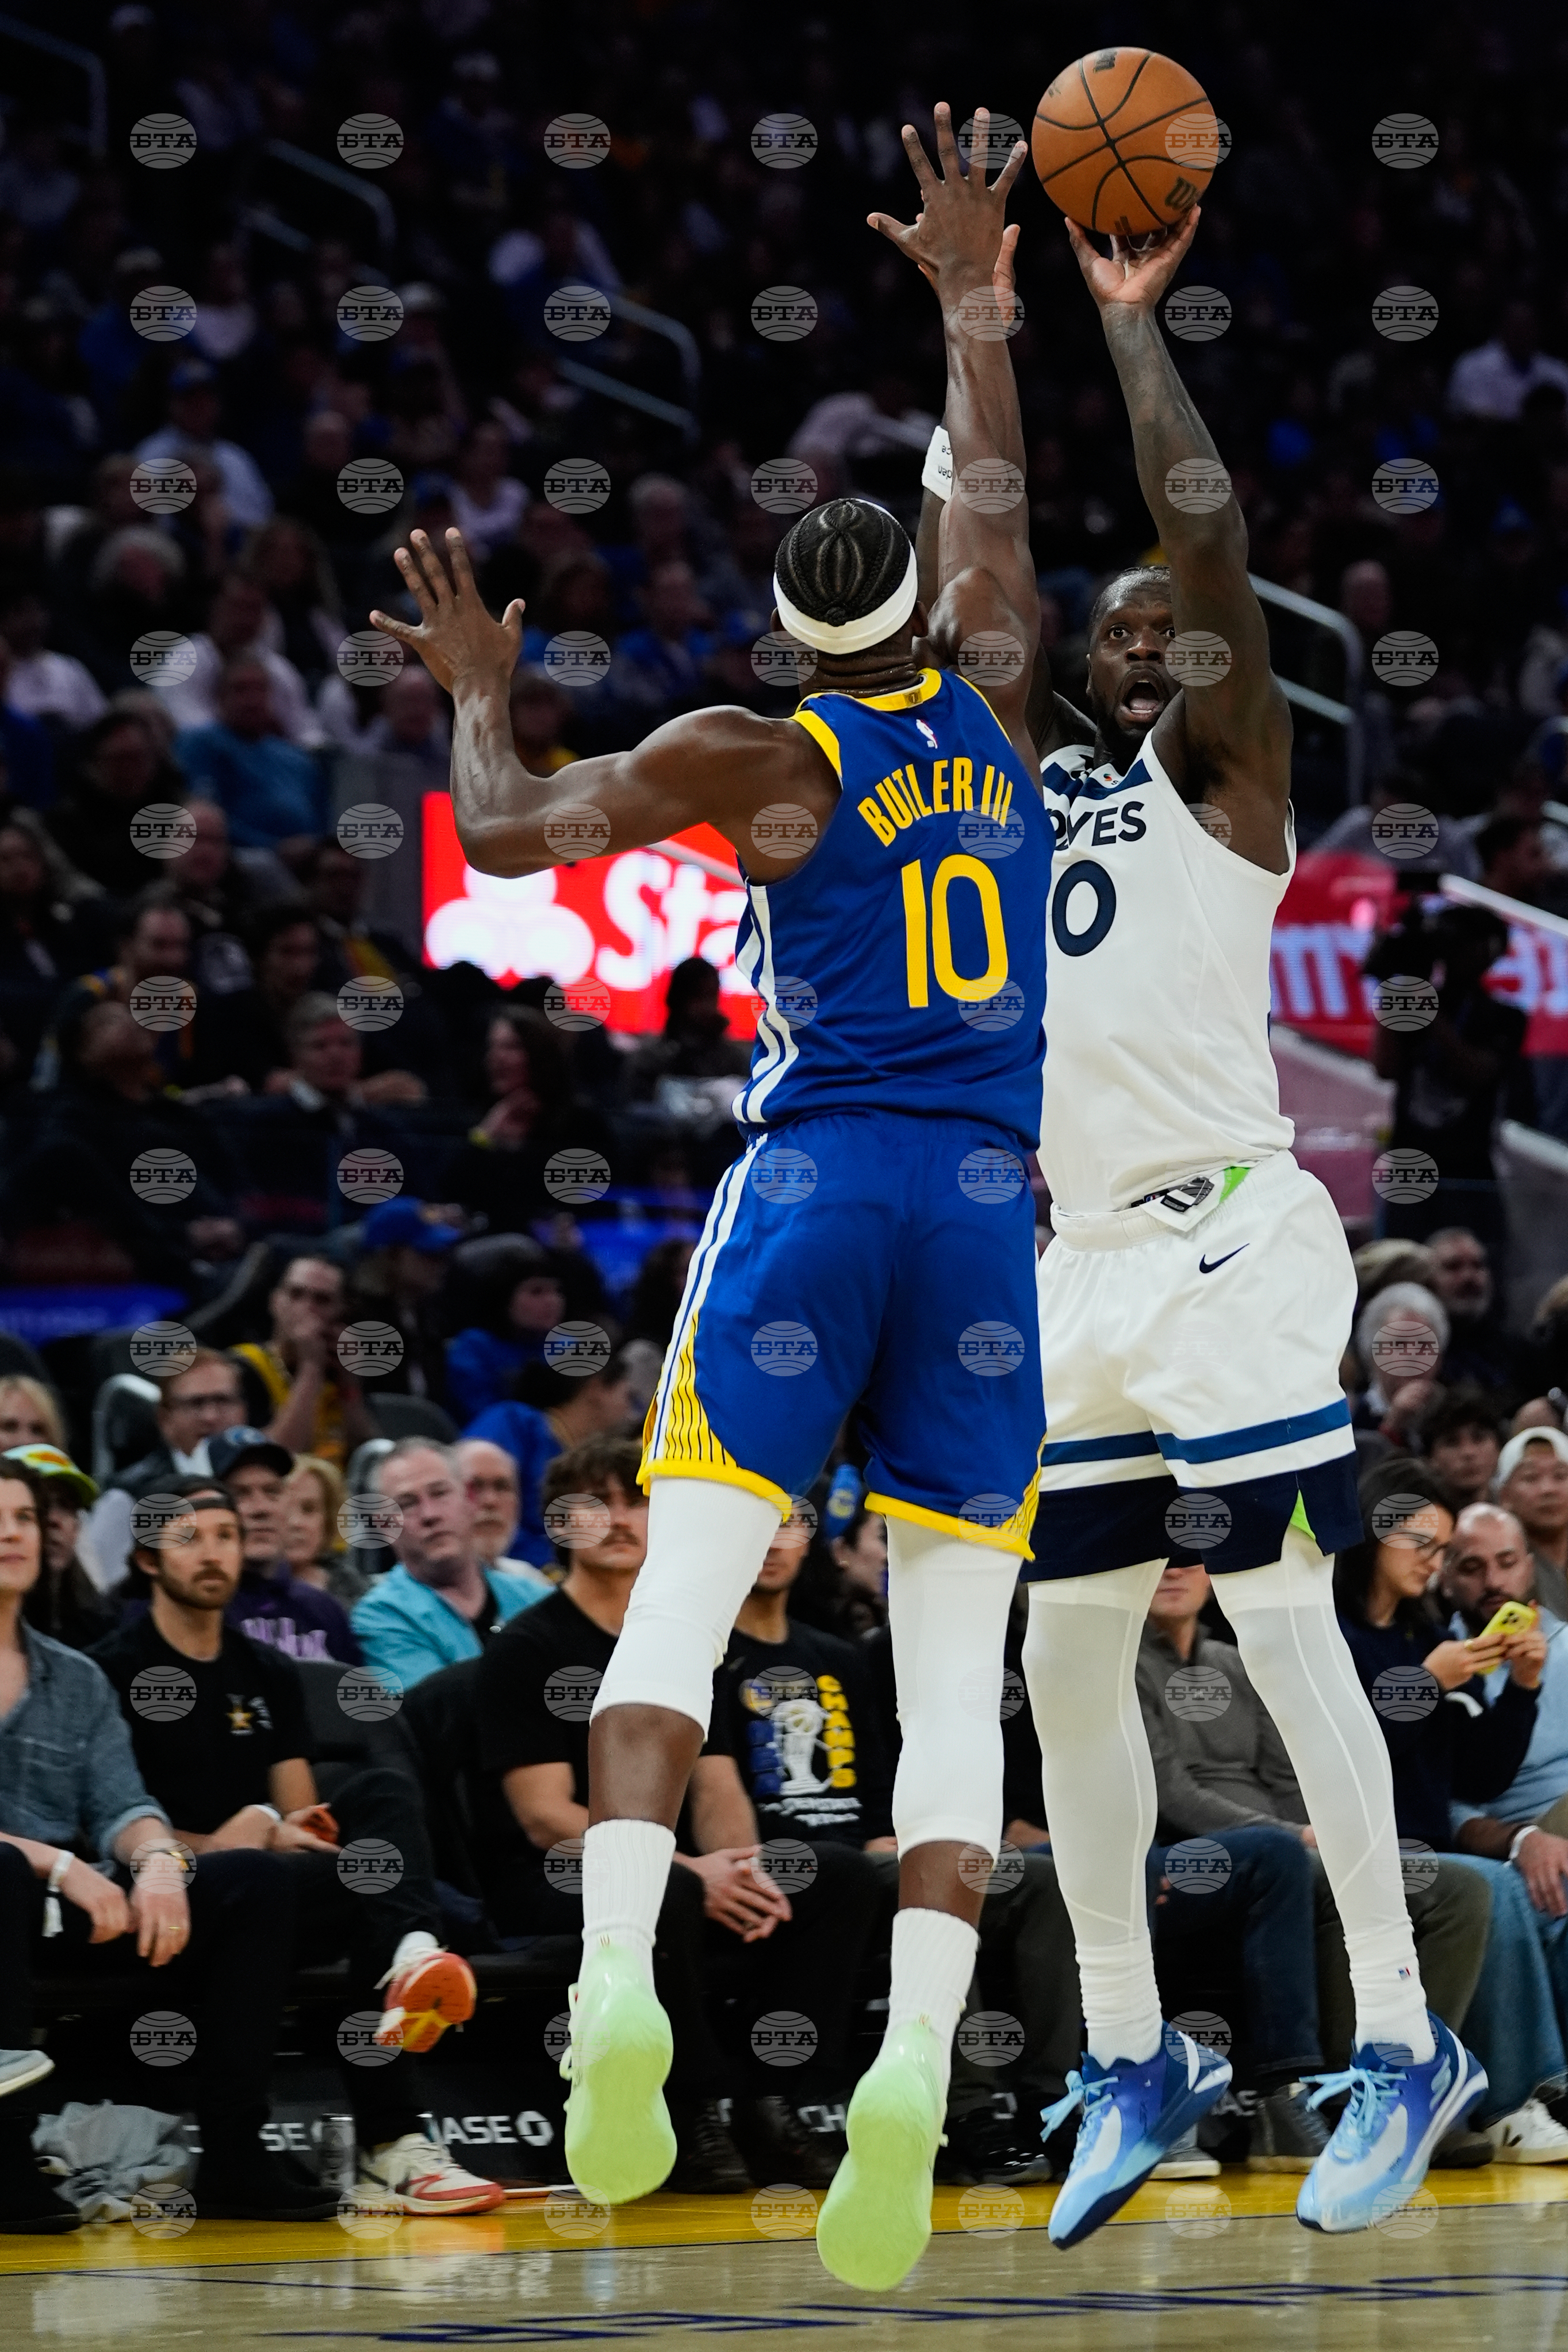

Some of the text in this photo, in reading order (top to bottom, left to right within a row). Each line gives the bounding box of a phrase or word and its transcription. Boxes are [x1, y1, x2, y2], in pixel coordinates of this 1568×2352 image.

[857, 757, 1013, 847] BUTLER III
[901, 854, 1009, 1009] 10
